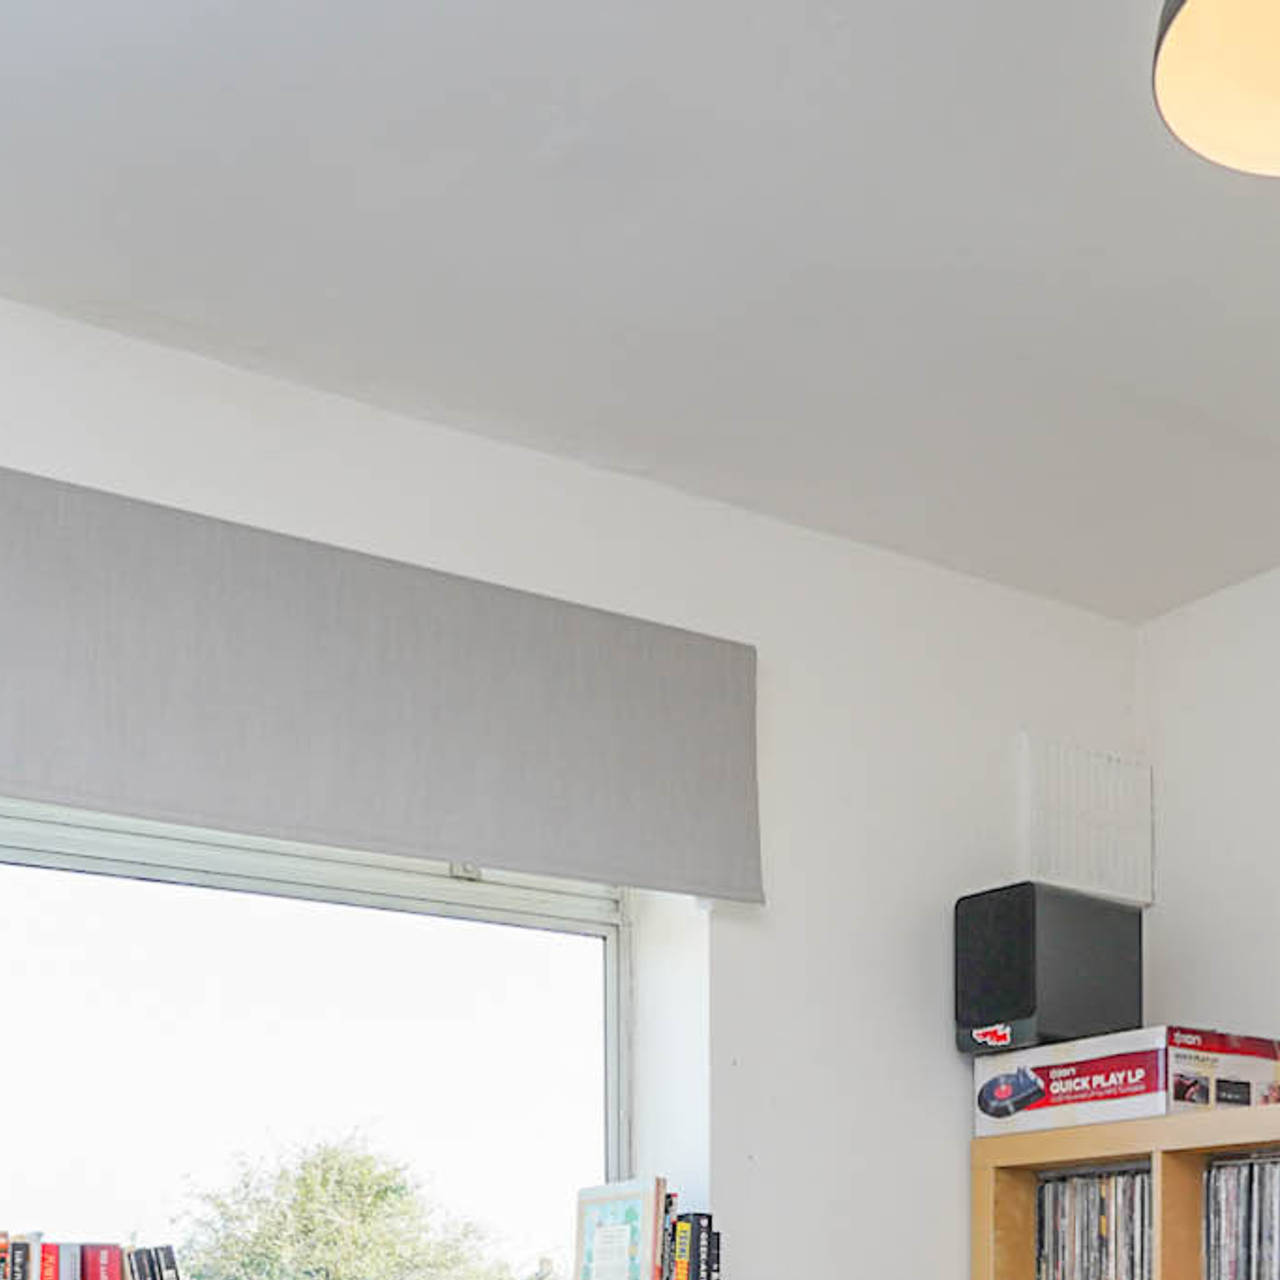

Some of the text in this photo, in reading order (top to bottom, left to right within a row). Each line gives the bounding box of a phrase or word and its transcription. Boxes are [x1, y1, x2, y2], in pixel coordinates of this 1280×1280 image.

[1049, 1075, 1090, 1094] QUICK
[1092, 1070, 1126, 1089] PLAY
[1127, 1067, 1146, 1084] LP
